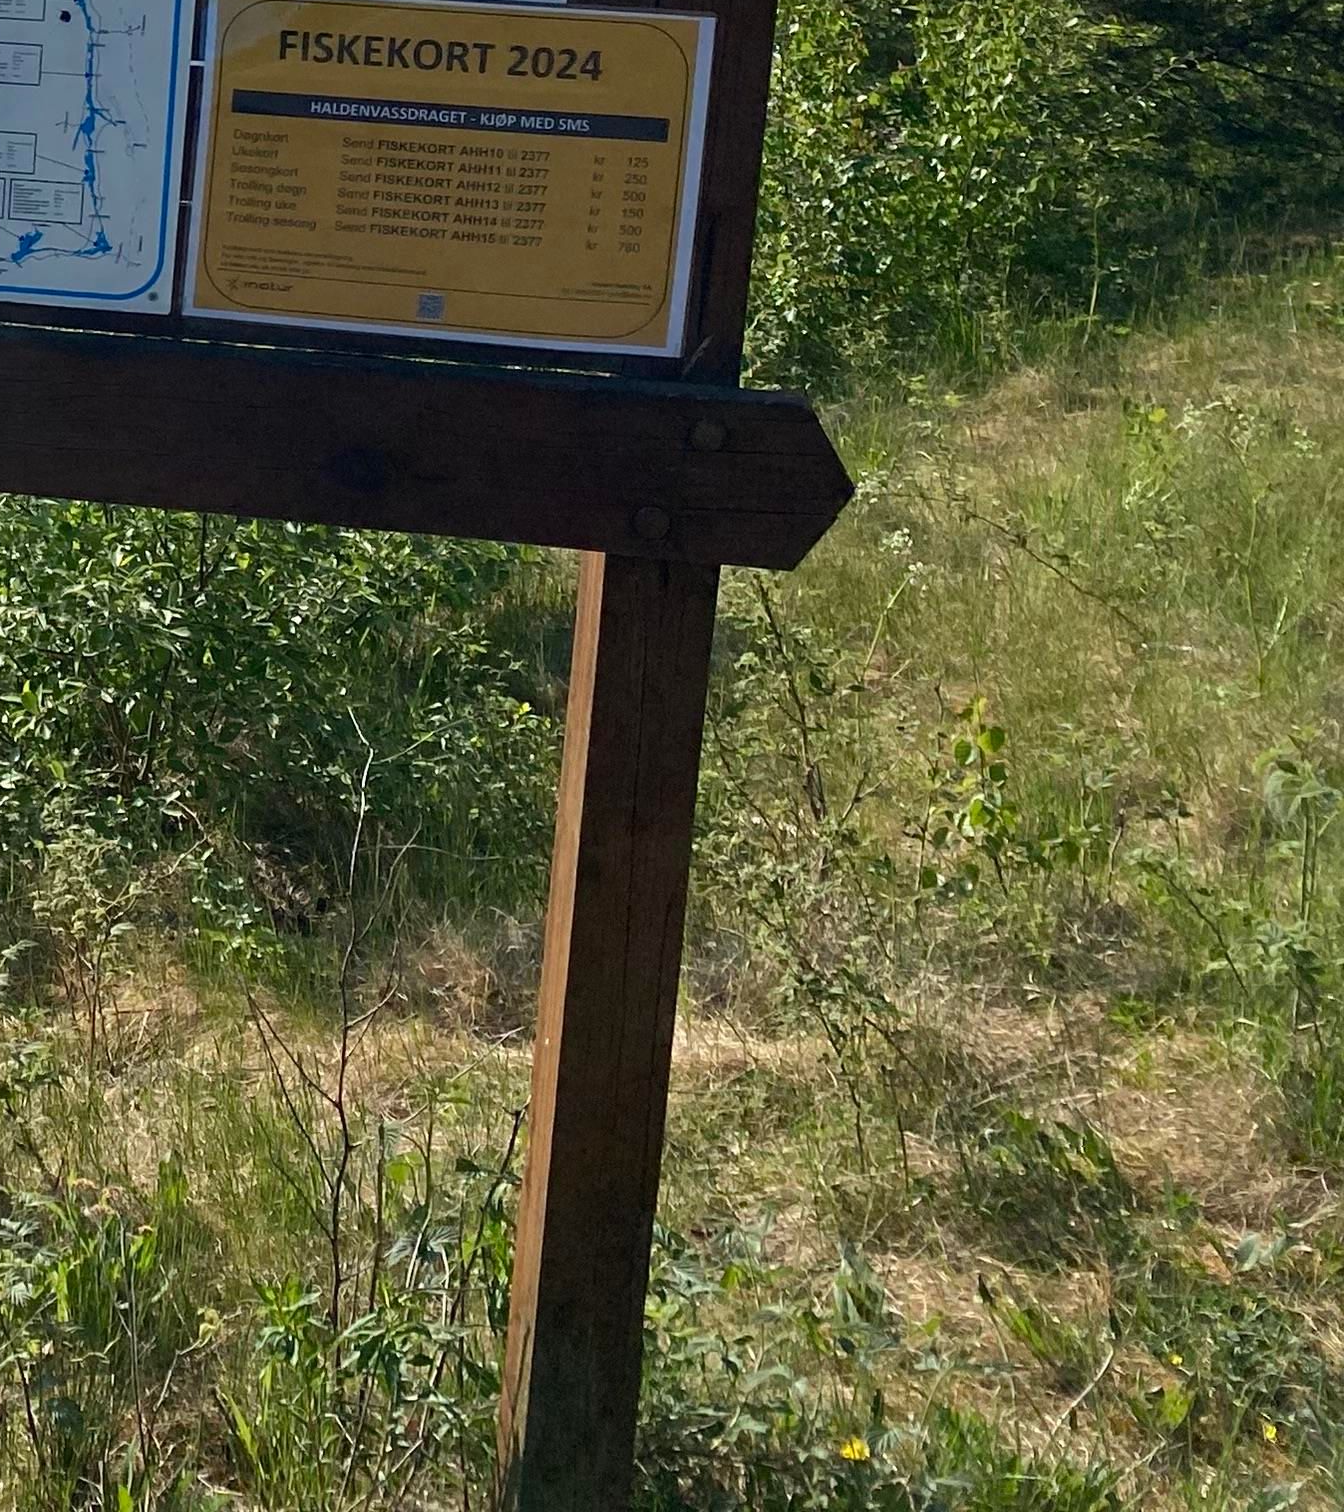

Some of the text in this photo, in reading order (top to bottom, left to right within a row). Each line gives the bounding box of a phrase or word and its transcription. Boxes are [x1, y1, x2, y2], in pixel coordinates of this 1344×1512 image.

[278, 29, 603, 81] FISKEKORT 2024
[310, 101, 466, 123] HALDENVASSDRAGET
[479, 111, 516, 128] KJØP
[519, 115, 555, 129] MED
[558, 118, 590, 132] SMS
[232, 128, 289, 145] Døgnkort
[341, 136, 374, 149] Send
[377, 139, 455, 155] FISKEKORT
[459, 145, 504, 158] AHH10
[520, 149, 550, 162] 2377
[593, 155, 605, 165] kr
[627, 156, 649, 168] 125
[229, 161, 299, 179] Sesongkort
[338, 170, 371, 183] Send
[374, 173, 452, 189] FISKEKORT
[456, 180, 500, 193] AHH12
[517, 183, 548, 196] 2377
[590, 189, 602, 199] kr
[622, 190, 646, 202] 500
[340, 153, 373, 167] Send
[376, 156, 454, 172] FISKEKORT
[457, 162, 501, 175] AHH11
[518, 167, 549, 179] 2377
[591, 171, 604, 182] kr
[623, 172, 648, 185] 250
[228, 194, 272, 211] Trolling
[335, 204, 368, 216] Send
[370, 206, 449, 223] FISKEKORT
[453, 213, 497, 226] AHH14
[514, 217, 544, 230] 2377
[586, 223, 598, 233] kr
[618, 224, 642, 236] 500
[229, 177, 273, 194] Trolling
[336, 186, 369, 200] Send
[372, 190, 450, 206] FISKEKORT
[454, 196, 499, 209] AHH13
[516, 200, 546, 213] 2377
[588, 206, 600, 216] kr
[621, 206, 644, 219] 150
[225, 211, 270, 227] Trolling
[334, 220, 366, 233] Send
[369, 223, 447, 239] FISKEKORT
[450, 230, 496, 244] AHH15
[511, 234, 542, 247] 2377
[585, 239, 597, 250] kr
